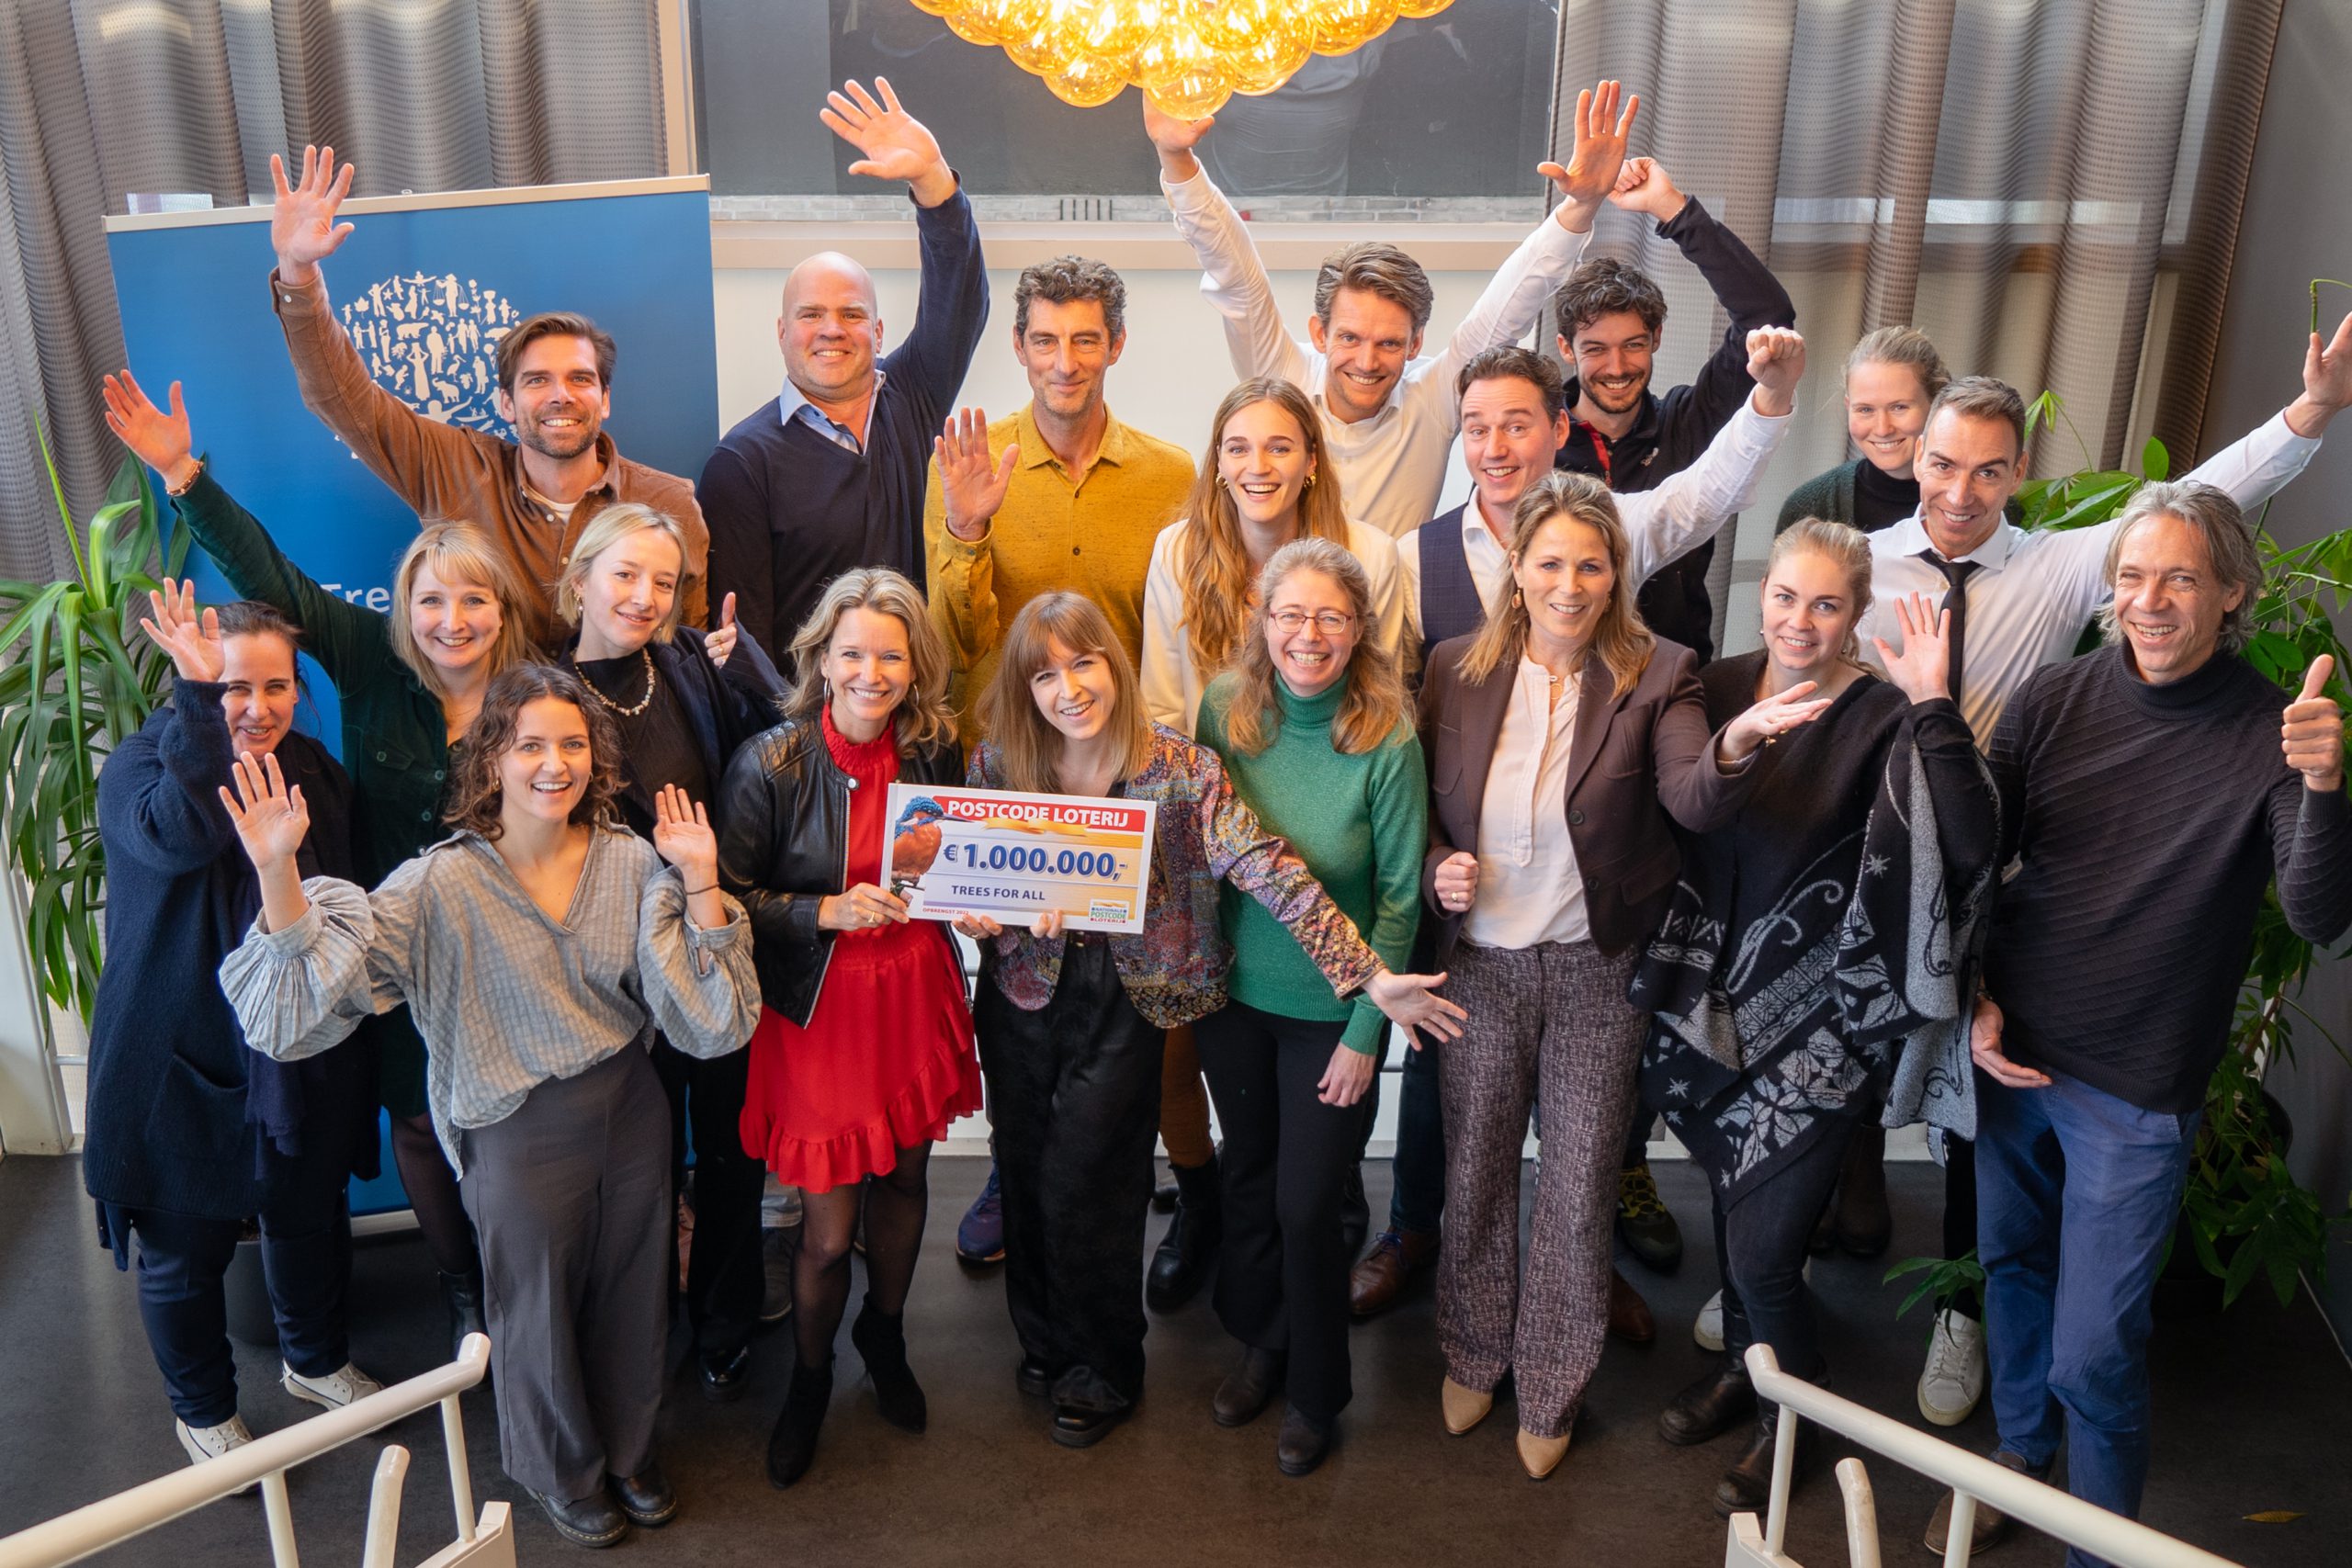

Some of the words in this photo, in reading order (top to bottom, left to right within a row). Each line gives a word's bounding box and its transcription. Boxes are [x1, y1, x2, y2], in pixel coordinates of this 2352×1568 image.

[947, 800, 1049, 821] POSTCODE
[1054, 808, 1129, 828] LOTERIJ
[943, 843, 957, 862] €
[964, 843, 1127, 880] 1.000.000,-
[951, 885, 990, 897] TREES
[993, 887, 1019, 899] FOR
[1022, 889, 1046, 901] ALL
